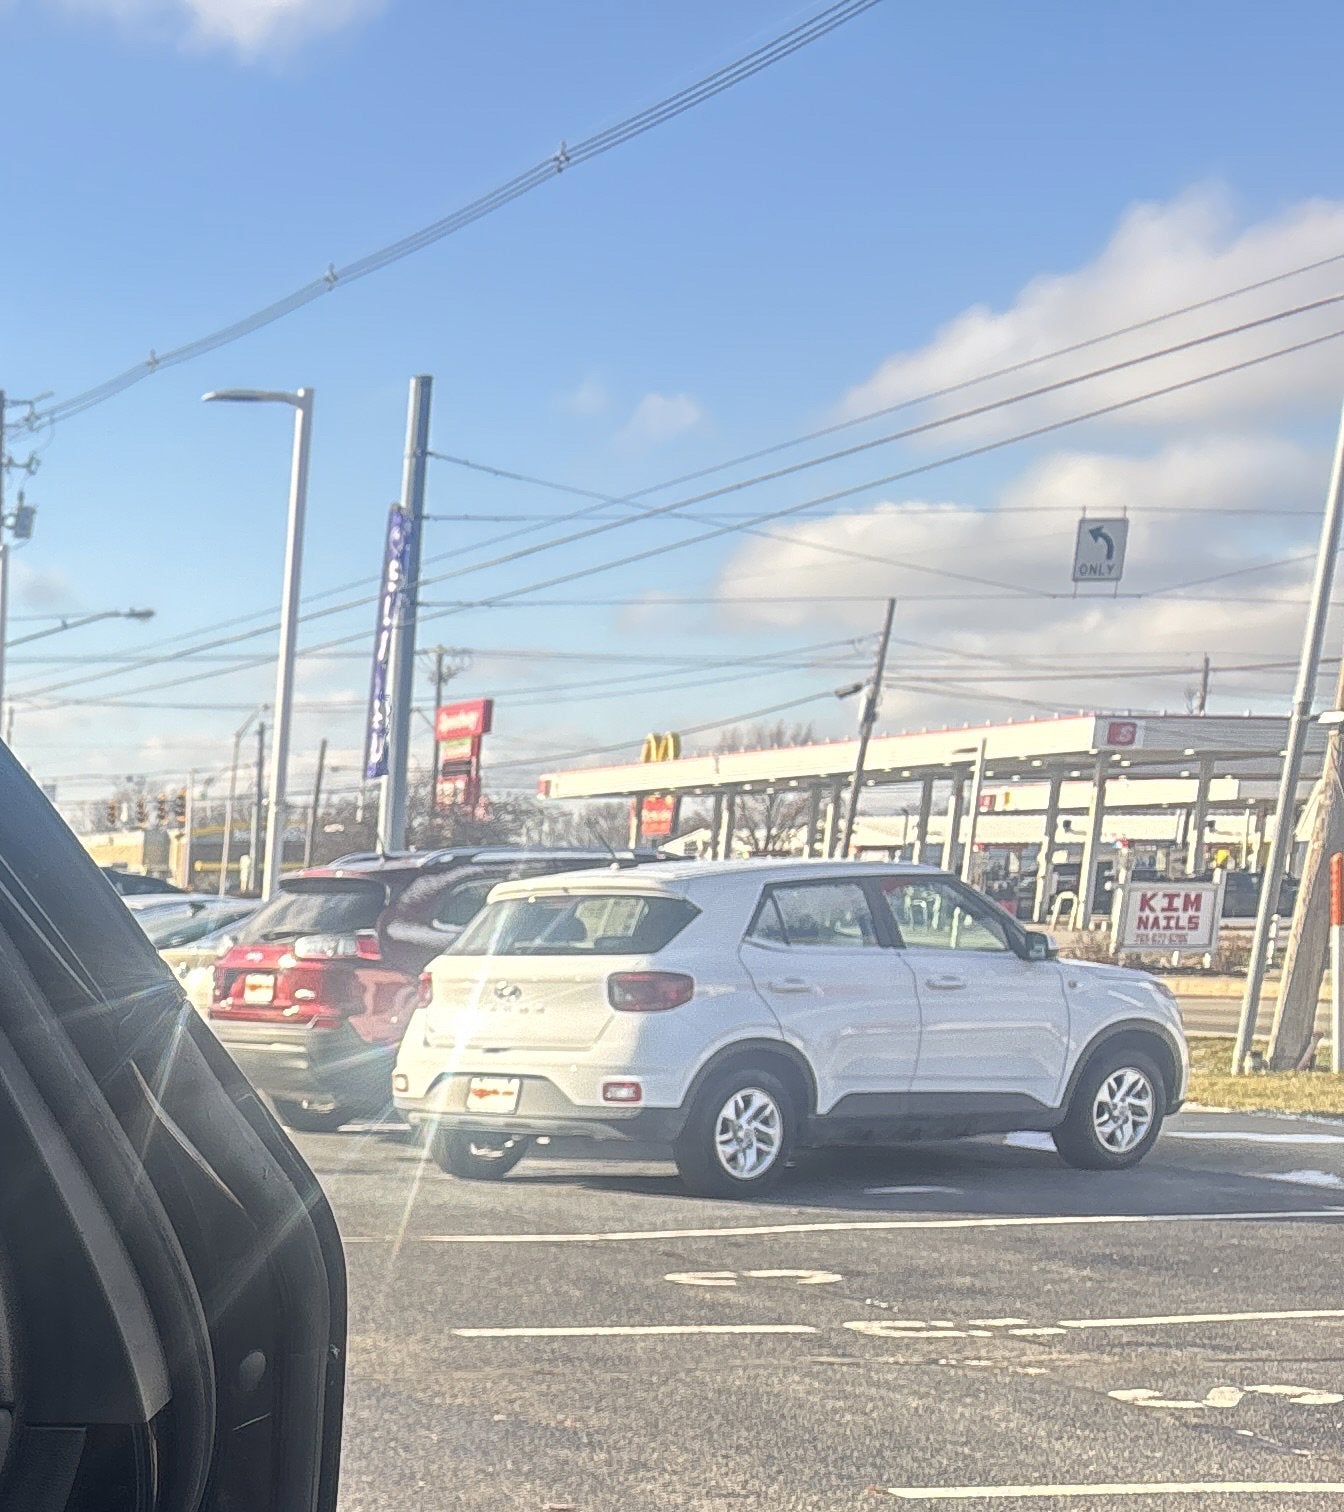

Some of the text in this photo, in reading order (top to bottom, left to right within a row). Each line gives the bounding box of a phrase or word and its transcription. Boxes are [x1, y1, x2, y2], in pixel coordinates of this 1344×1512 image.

[1079, 563, 1116, 577] ONLY
[1139, 893, 1203, 912] KIM
[1137, 914, 1200, 930] NAILS
